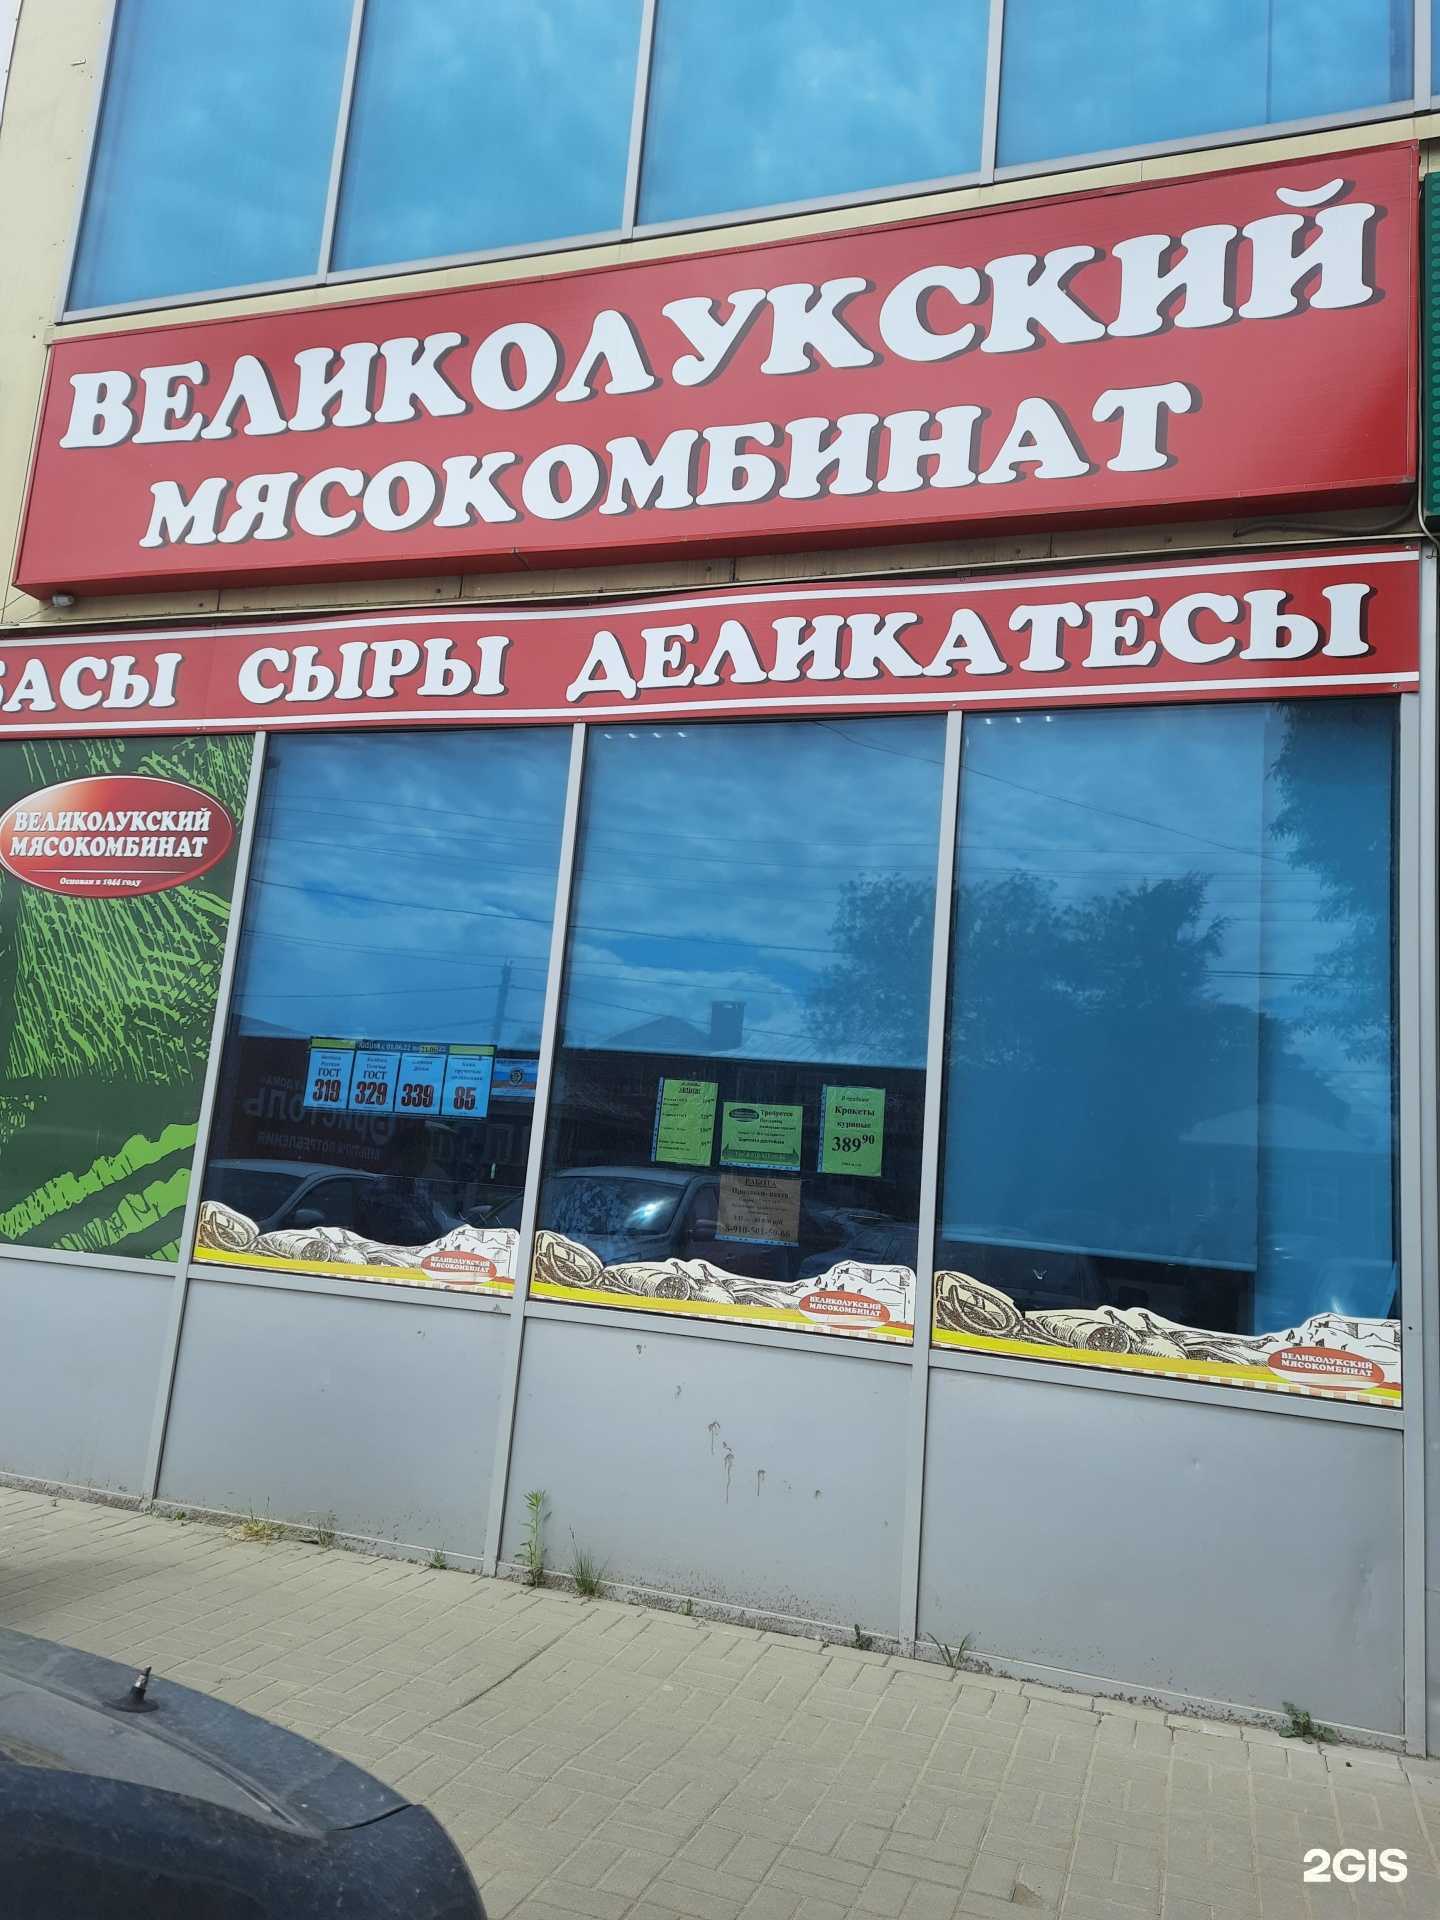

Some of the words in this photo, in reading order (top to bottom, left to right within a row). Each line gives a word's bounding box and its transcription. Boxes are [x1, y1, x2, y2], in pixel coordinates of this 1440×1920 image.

[58, 177, 1378, 450] ВЕЛИКОЛУКСКИЙ
[138, 380, 1196, 549] МЯСОКОМБИНАТ
[237, 635, 511, 705] СЫРЫ
[565, 582, 1376, 704] ДЕЛИКАТЕСЫ
[13, 807, 212, 832] ВЕЛИКОЛУКСКИЙ
[9, 836, 208, 858] МЯСОКОМБИНАТ
[318, 1066, 342, 1078] ГОСТ
[363, 1070, 388, 1081] ГОСТ
[312, 1078, 342, 1103] 319
[354, 1081, 388, 1106] 329
[400, 1083, 435, 1108] 339
[453, 1086, 477, 1111] 85
[1281, 1351, 1373, 1370] ВЕЛИКОЛУКСКИЙ
[1281, 1359, 1373, 1378] МЯСОКОМБИНАТ
